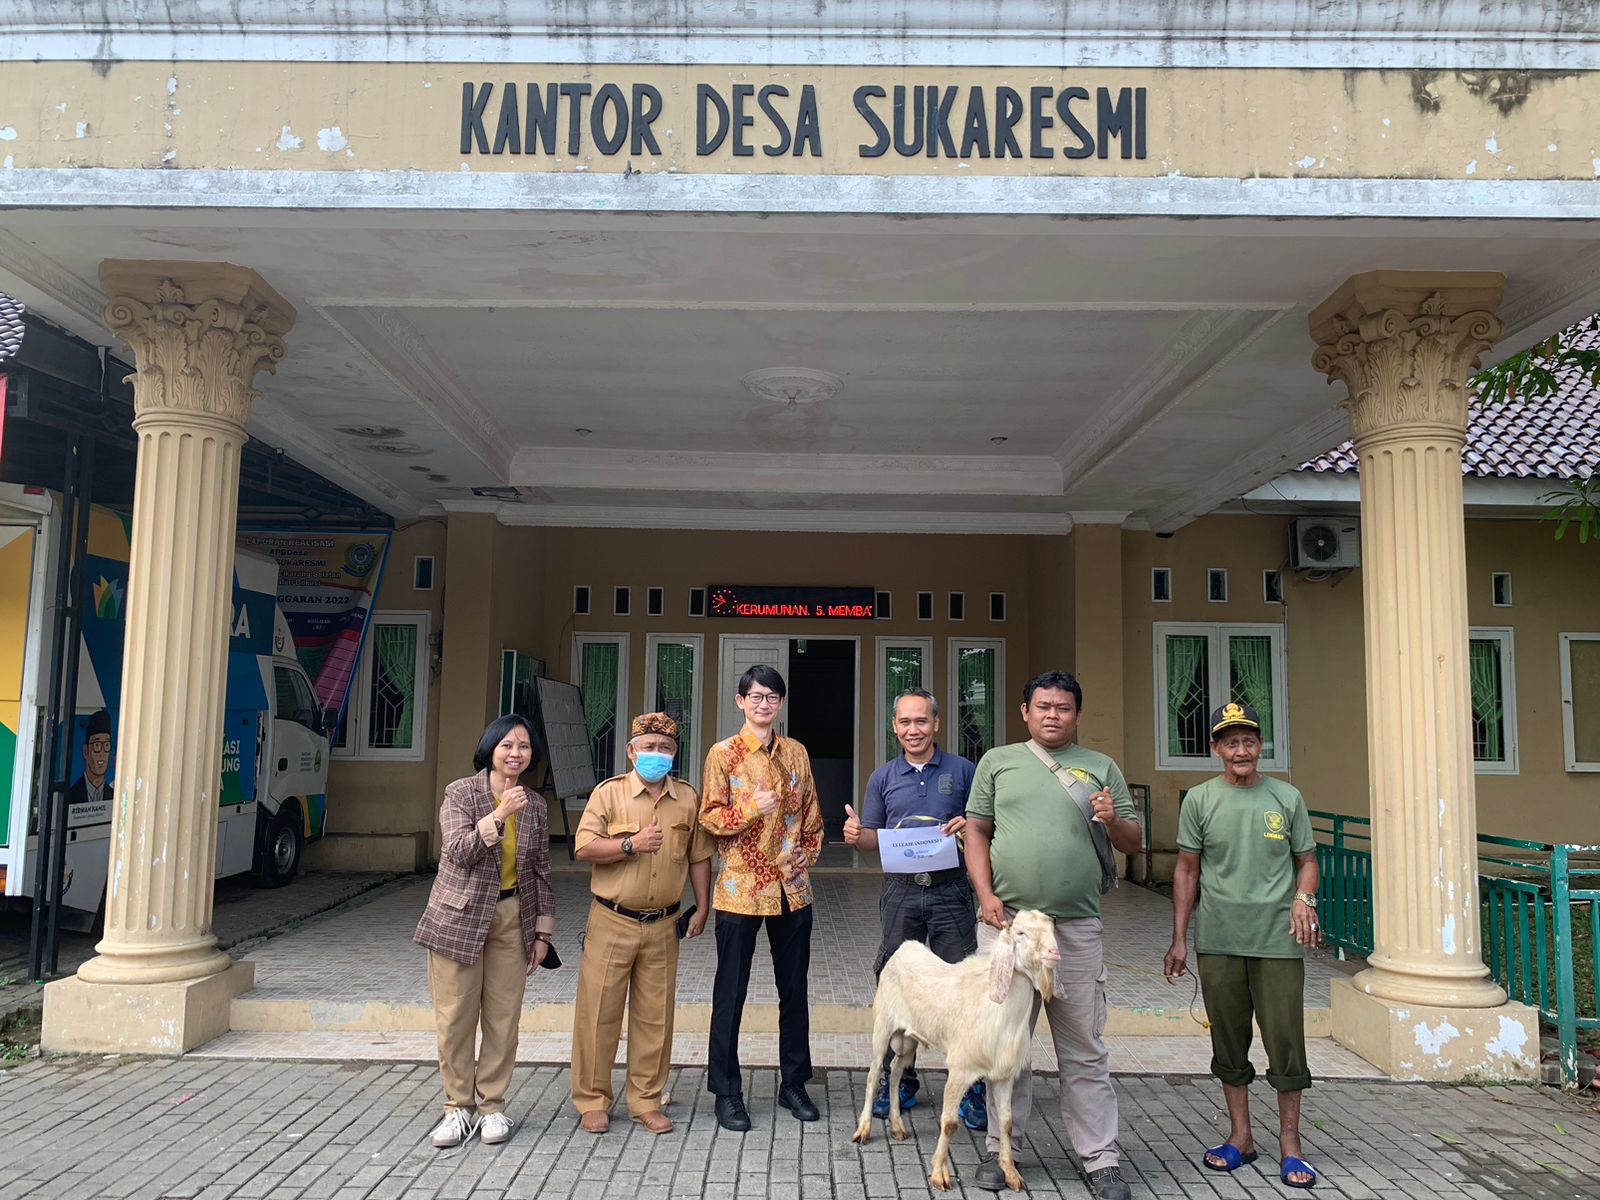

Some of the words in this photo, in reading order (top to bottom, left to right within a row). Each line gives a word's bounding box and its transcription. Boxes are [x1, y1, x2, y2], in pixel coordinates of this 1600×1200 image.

[460, 82, 662, 156] KANTOR
[696, 83, 822, 157] DESA
[852, 85, 1147, 160] SUKARESMI
[287, 540, 335, 548] REALISASI
[324, 596, 350, 605] 2022
[736, 604, 811, 616] KERUMUNAN.
[816, 605, 826, 616] 5.
[828, 605, 873, 617] MEMBA
